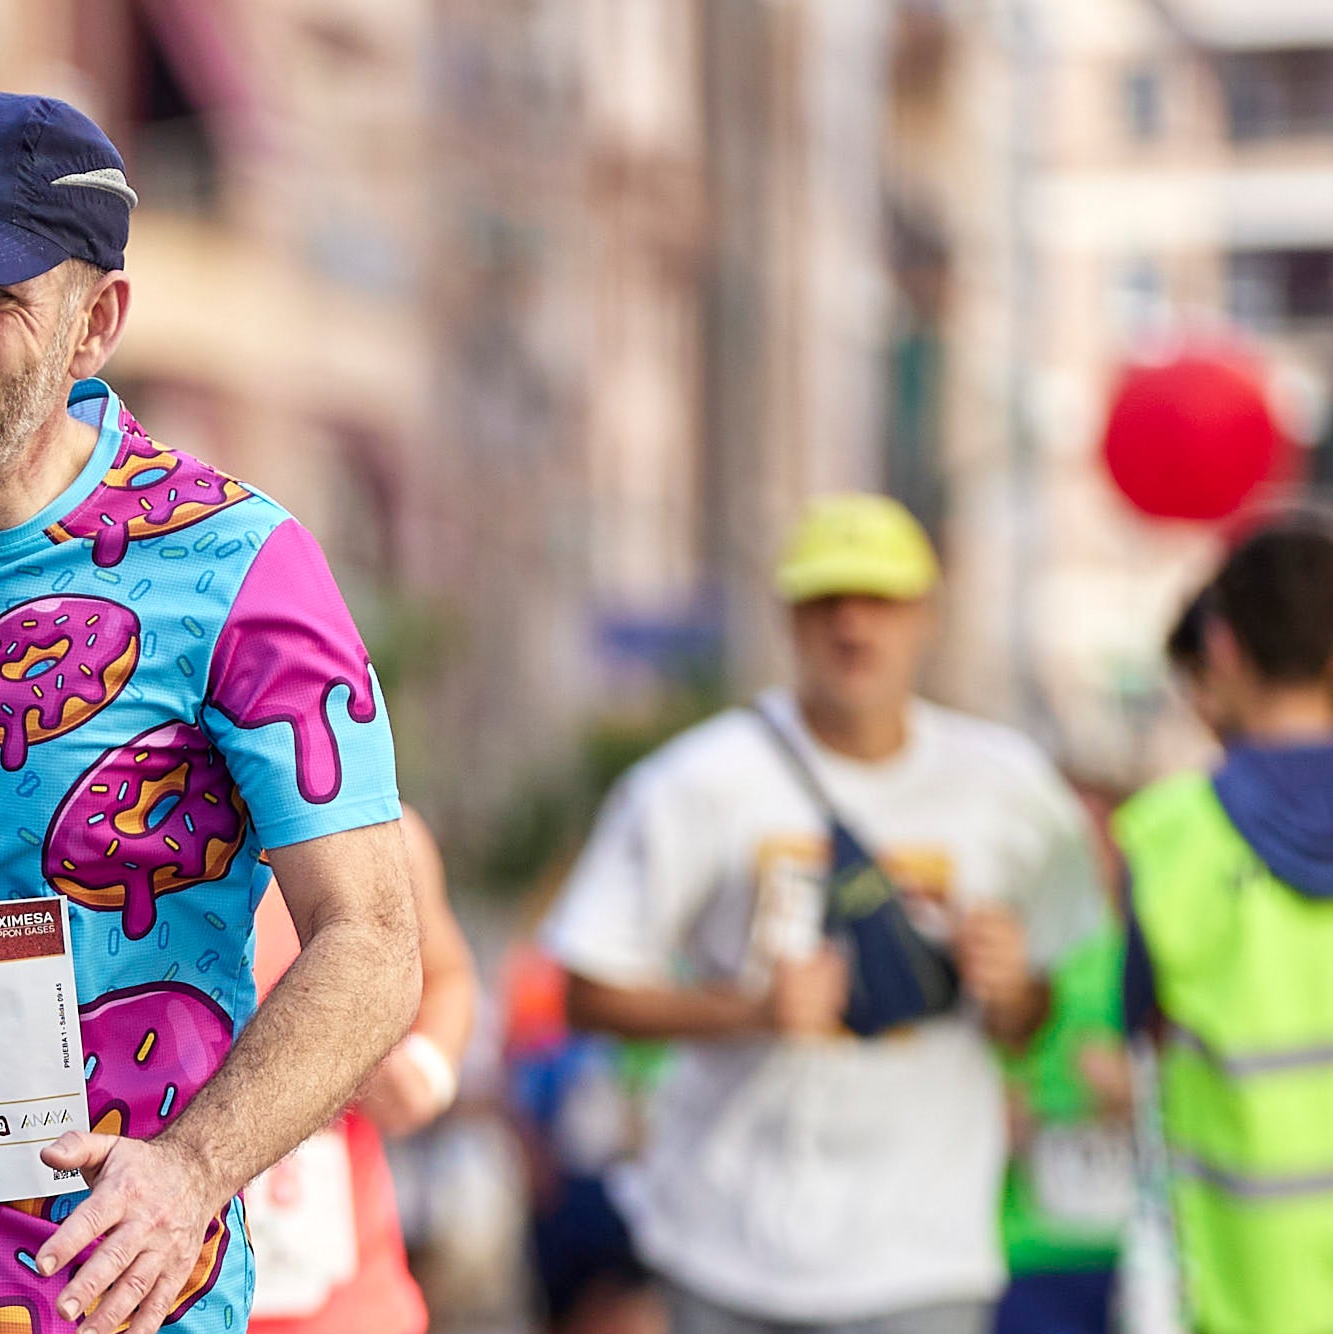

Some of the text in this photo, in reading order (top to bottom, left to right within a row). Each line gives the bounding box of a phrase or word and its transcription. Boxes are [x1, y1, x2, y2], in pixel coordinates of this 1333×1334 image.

[25, 925, 55, 936] GASES
[62, 1037, 70, 1068] PRUEBA
[21, 1109, 74, 1128] ANAYA
